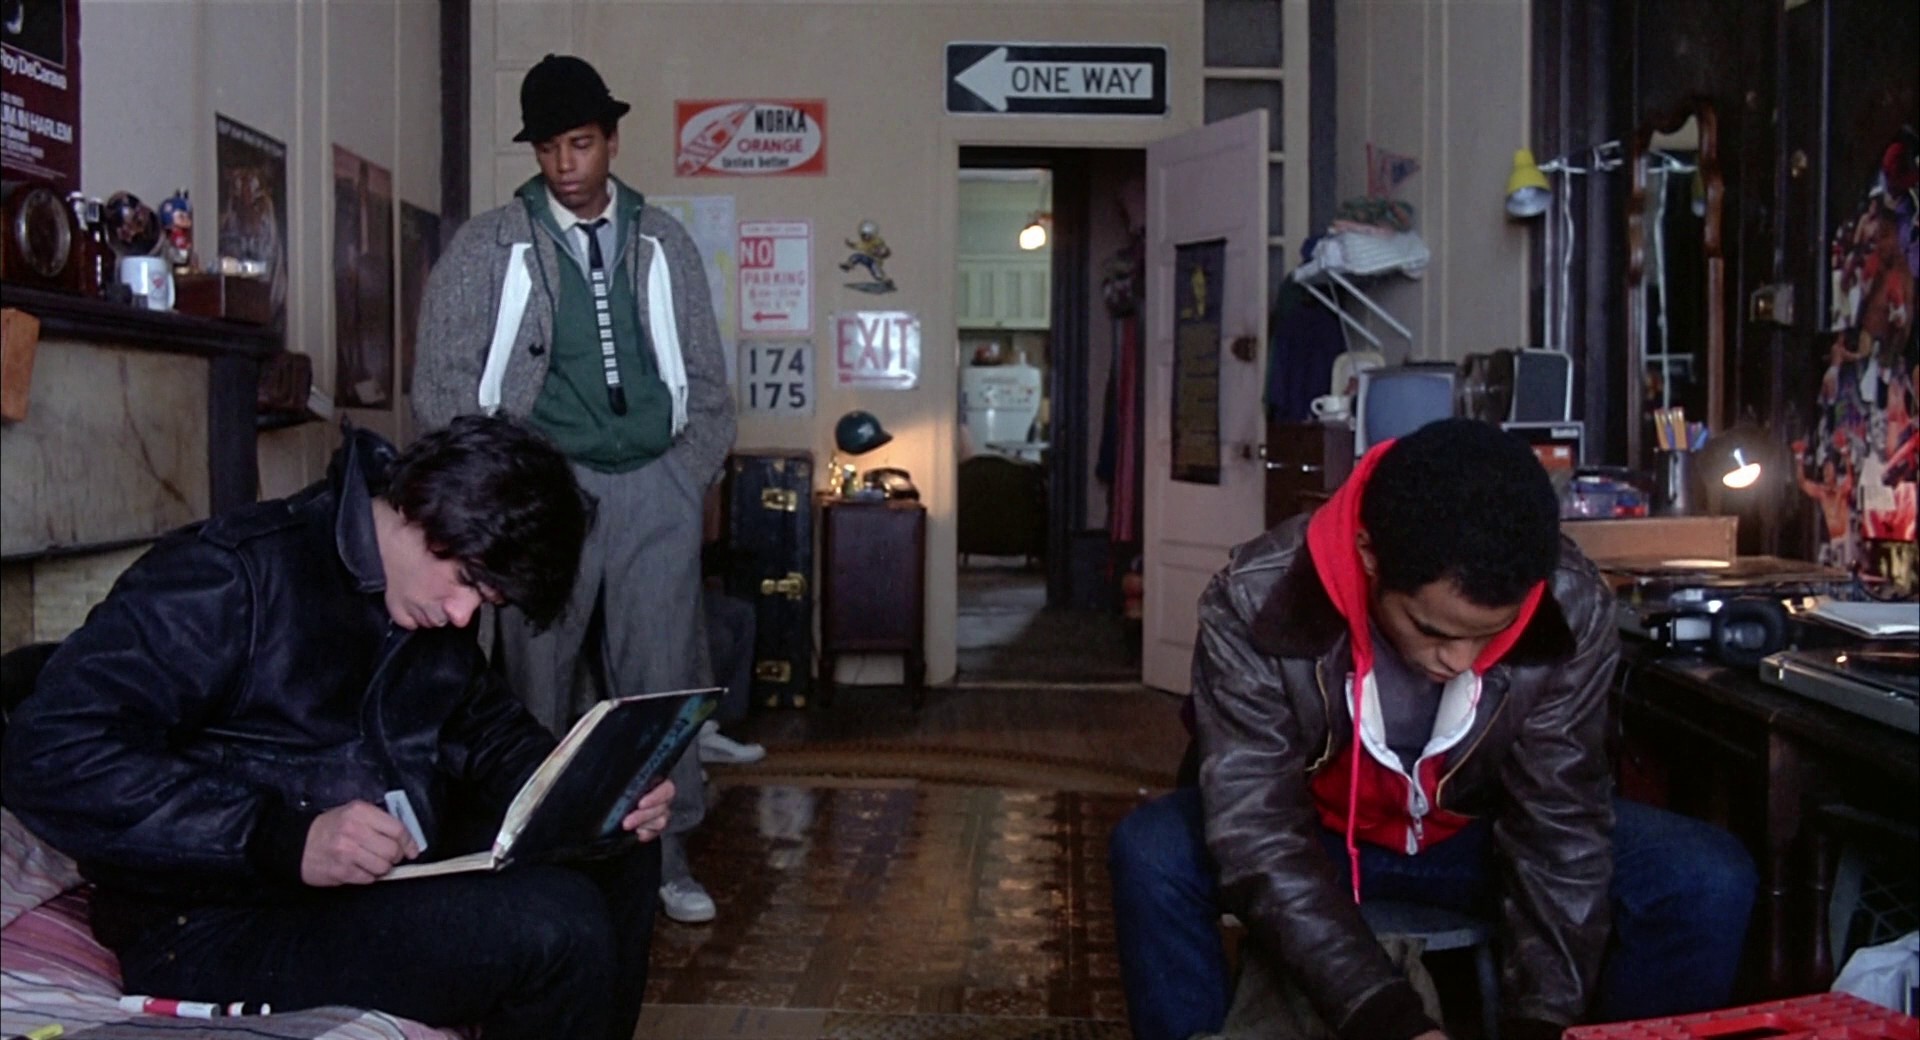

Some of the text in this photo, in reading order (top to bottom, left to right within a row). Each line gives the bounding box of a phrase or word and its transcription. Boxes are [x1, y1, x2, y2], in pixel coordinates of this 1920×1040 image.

[1011, 66, 1142, 94] ONE WAY
[30, 112, 73, 144] HARLEM
[755, 109, 807, 133] NORKA
[737, 138, 802, 153] ORANGE
[758, 156, 789, 168] better
[741, 240, 773, 265] NO
[744, 271, 805, 286] PARKING
[837, 318, 912, 370] EXIT
[750, 349, 804, 375] 174
[750, 383, 806, 408] 175
